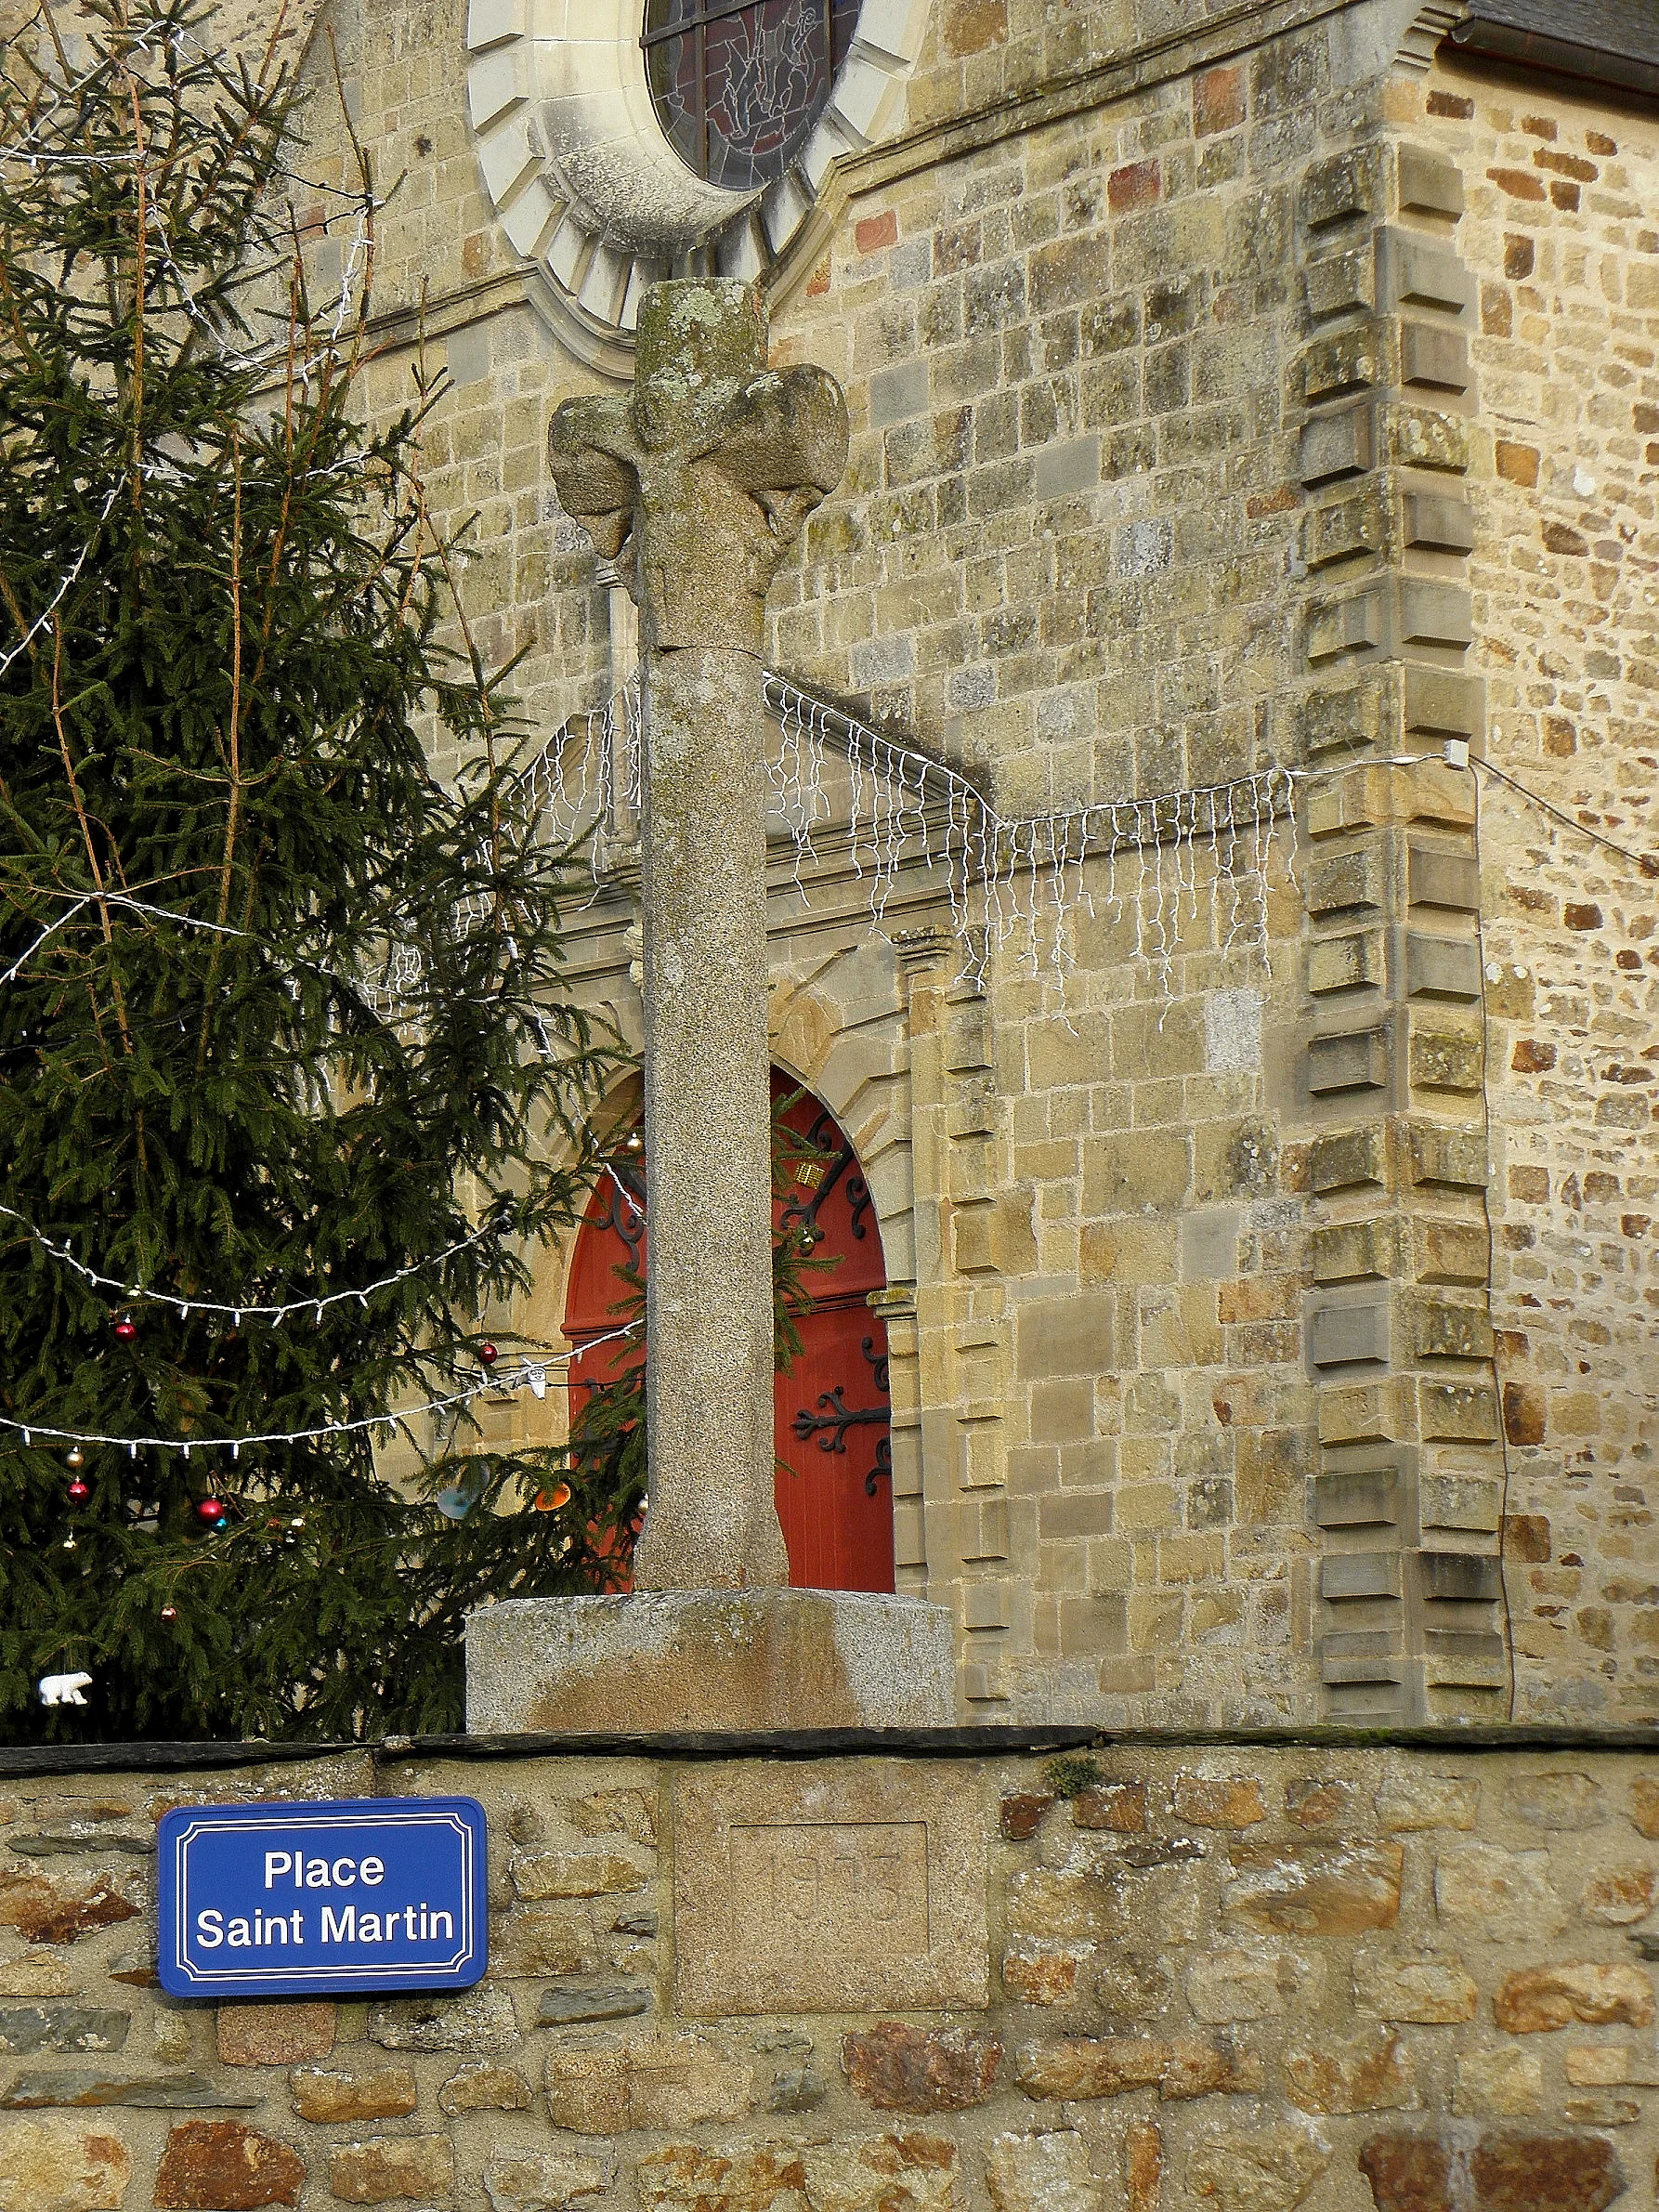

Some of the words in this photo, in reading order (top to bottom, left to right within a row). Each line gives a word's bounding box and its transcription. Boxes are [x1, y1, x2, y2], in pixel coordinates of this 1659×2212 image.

[264, 1851, 385, 1889] Place
[196, 1908, 304, 1948] Saint
[320, 1903, 453, 1943] Martin
